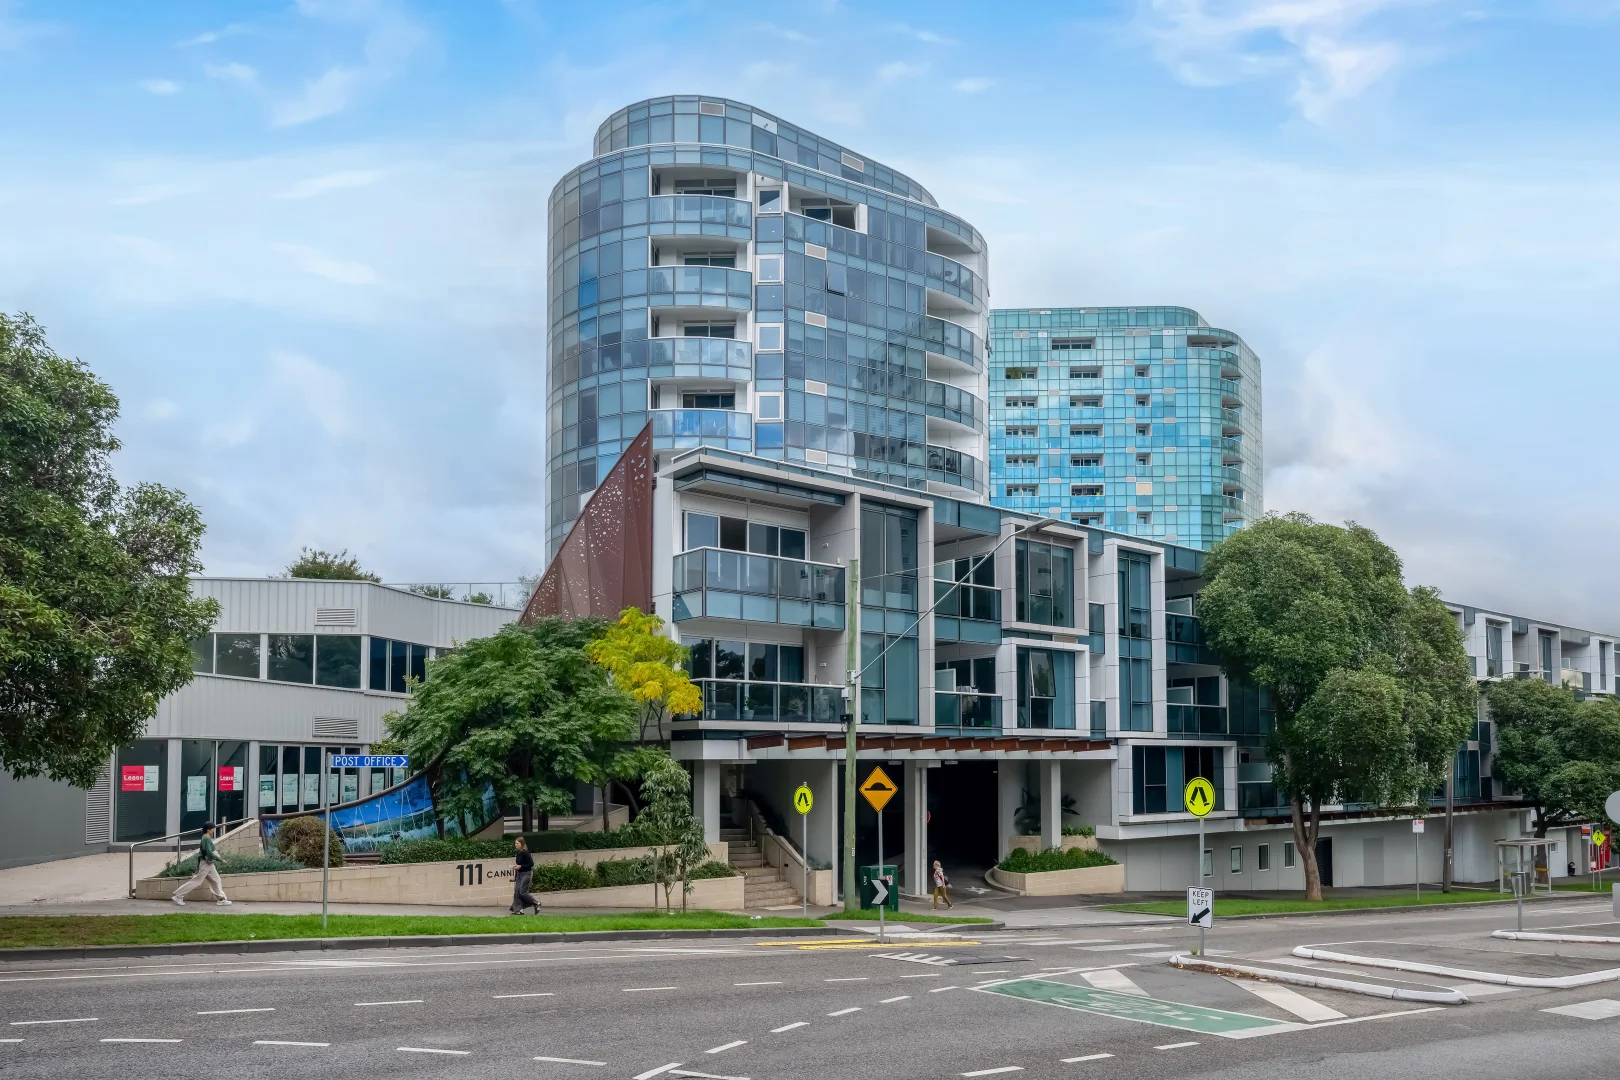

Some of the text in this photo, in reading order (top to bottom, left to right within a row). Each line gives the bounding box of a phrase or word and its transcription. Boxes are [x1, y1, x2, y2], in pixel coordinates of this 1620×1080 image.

[335, 756, 397, 766] POST OFFICE
[456, 863, 515, 886] 111 CANNI
